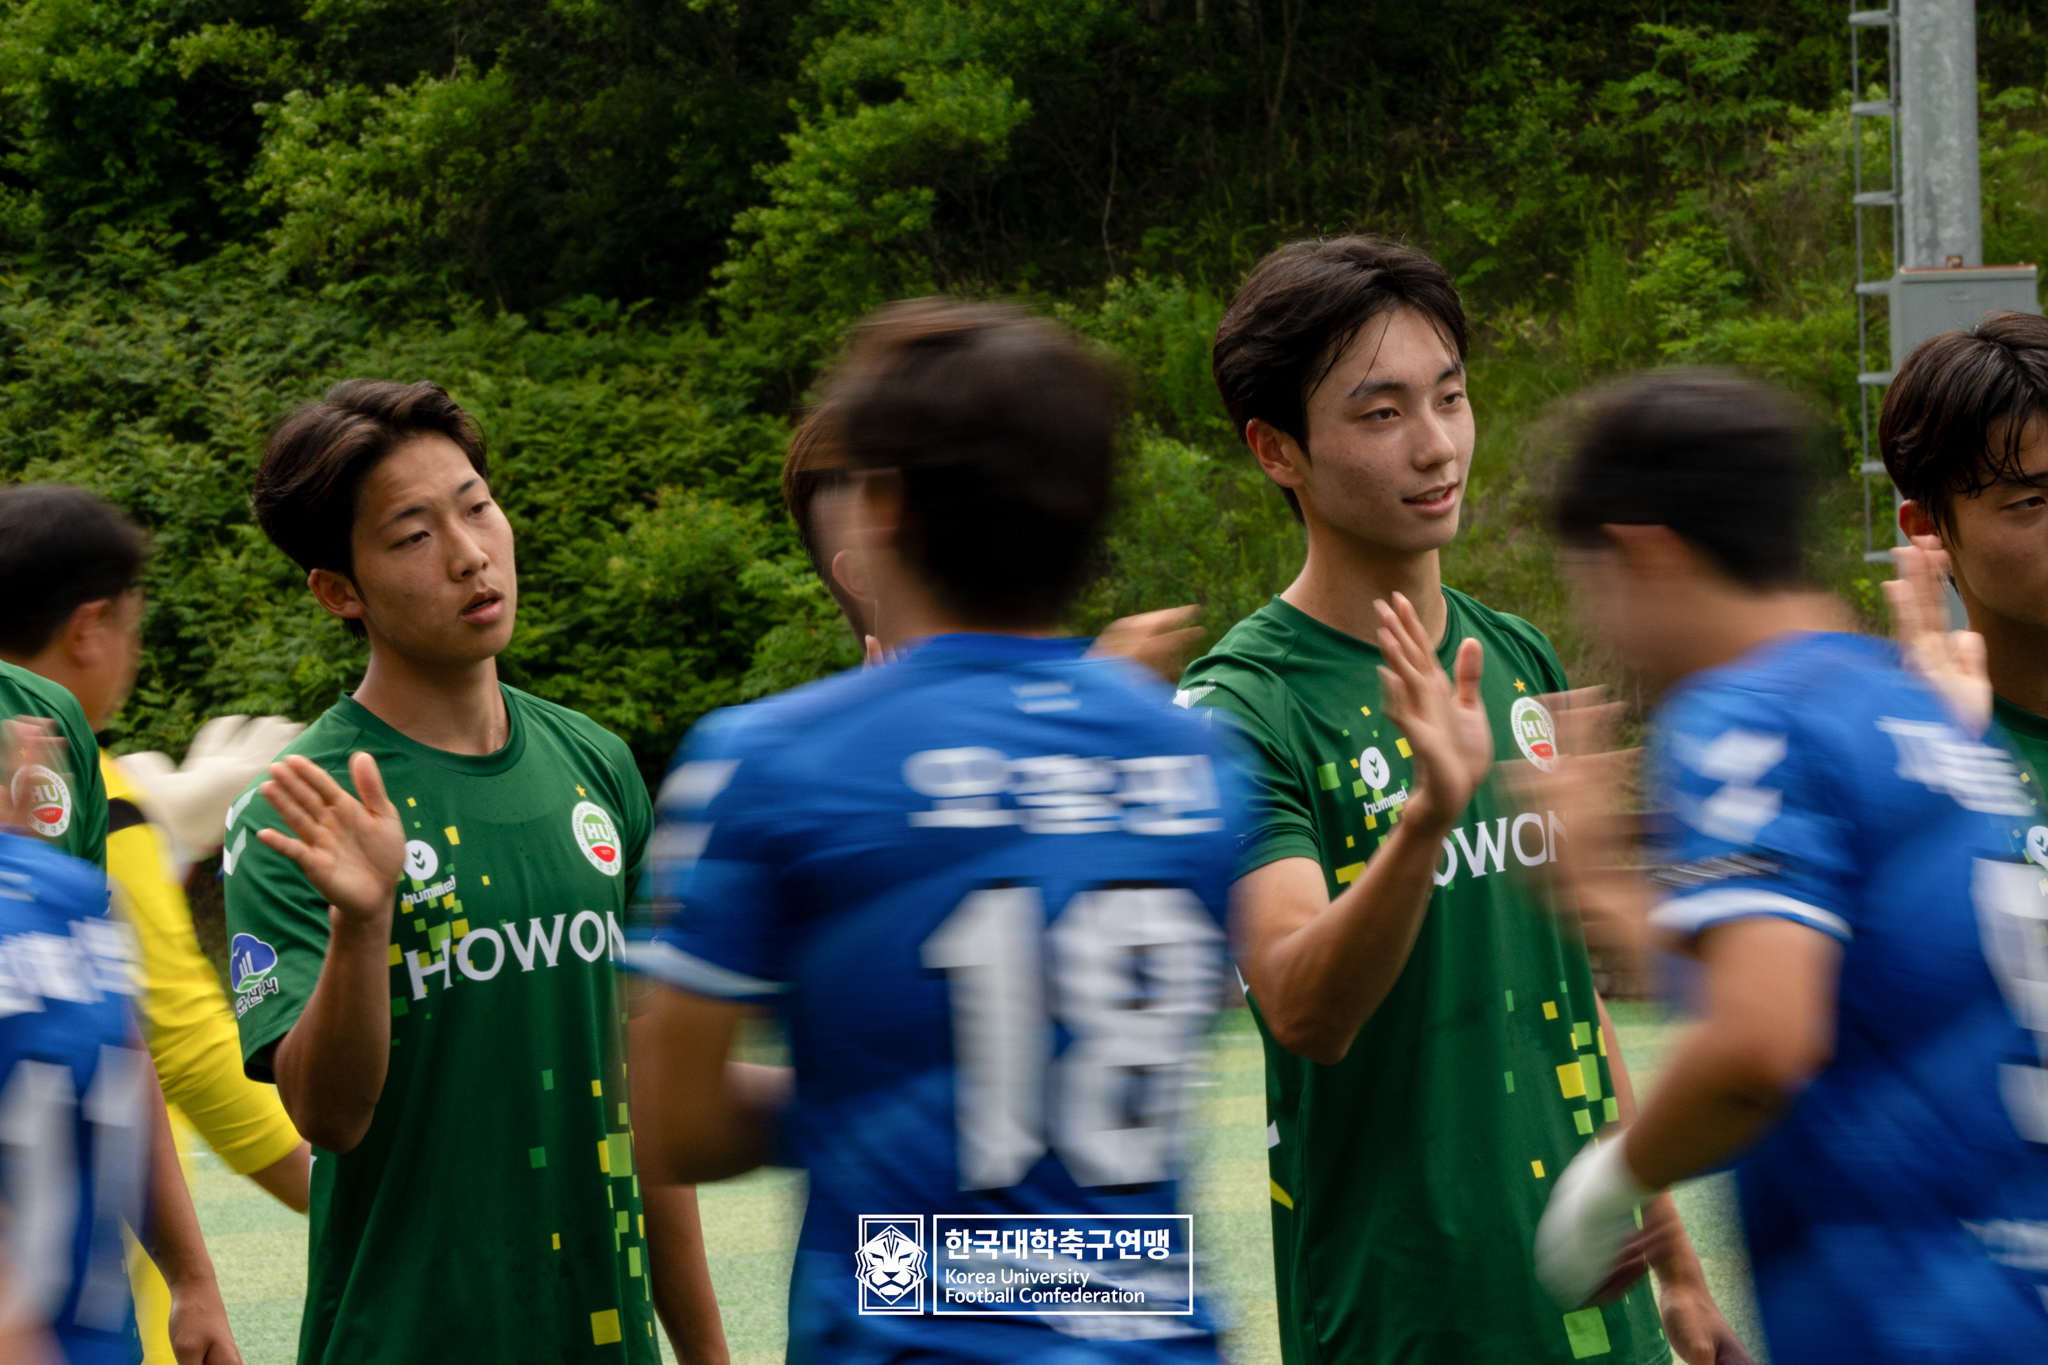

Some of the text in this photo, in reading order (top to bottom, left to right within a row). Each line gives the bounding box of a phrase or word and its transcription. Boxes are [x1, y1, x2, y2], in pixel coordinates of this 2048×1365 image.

[1522, 720, 1548, 738] HU
[1363, 786, 1408, 816] hummel
[583, 823, 612, 842] HU
[1431, 810, 1568, 887] OWON
[402, 875, 456, 907] hummel
[403, 910, 626, 1001] HOWON
[236, 976, 279, 1019] 군산시
